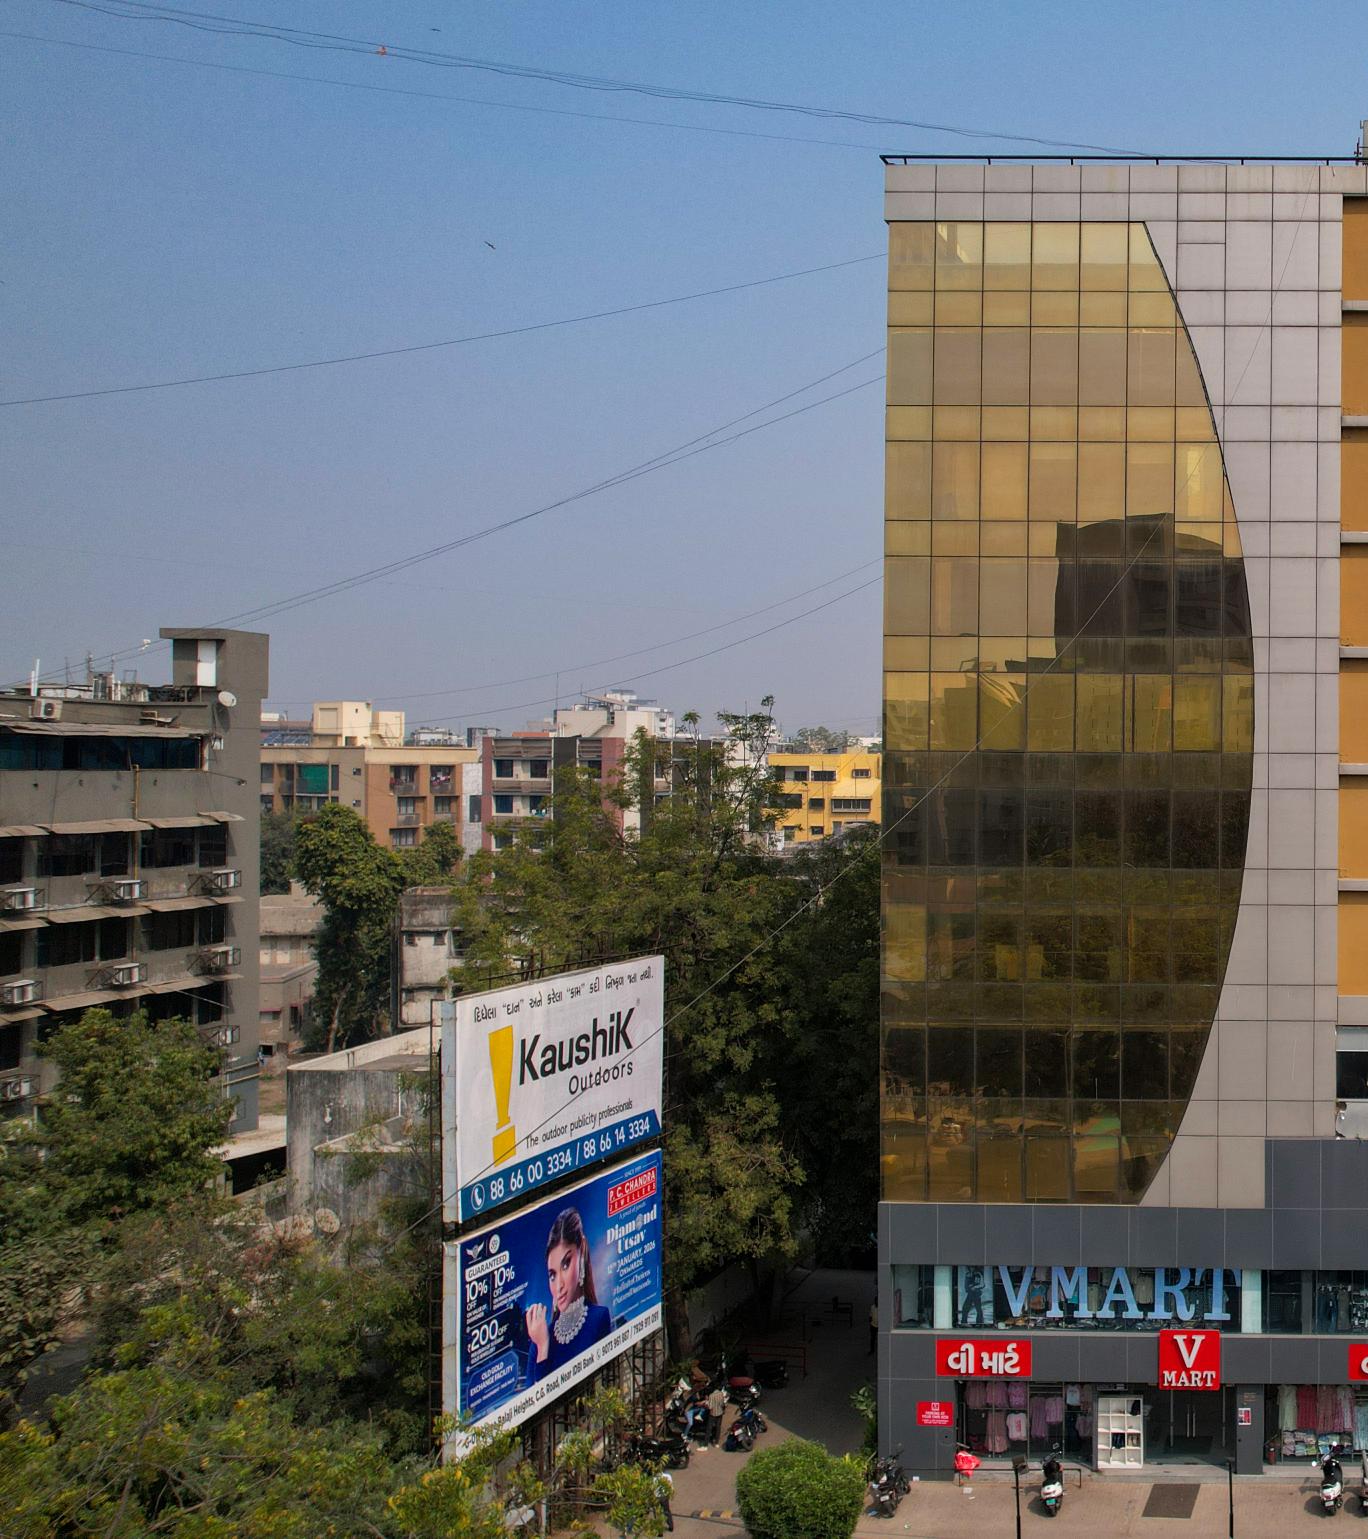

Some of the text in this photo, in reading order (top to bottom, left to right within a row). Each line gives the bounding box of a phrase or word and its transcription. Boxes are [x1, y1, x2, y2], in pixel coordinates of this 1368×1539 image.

[568, 1061, 634, 1095] Outdoors
[525, 1097, 633, 1149] The outdoor publicity professionals
[490, 1177, 504, 1201] 88
[510, 1169, 524, 1192] 66
[527, 1161, 543, 1184] 00
[547, 1148, 572, 1175] 3334
[583, 1138, 596, 1159] 88
[600, 1132, 612, 1152] 66
[614, 1127, 625, 1146] 14
[628, 1116, 650, 1140] 3334
[624, 1170, 656, 1194] CHANDRA
[618, 1229, 646, 1254] Utsav
[468, 1254, 506, 1279] GUARANTEED
[947, 1342, 1021, 1374] વી માર્ટ
[1173, 1334, 1206, 1369] V
[560, 1370, 572, 1385] Near
[583, 1354, 595, 1370] Bank
[1162, 1370, 1216, 1388] MART
